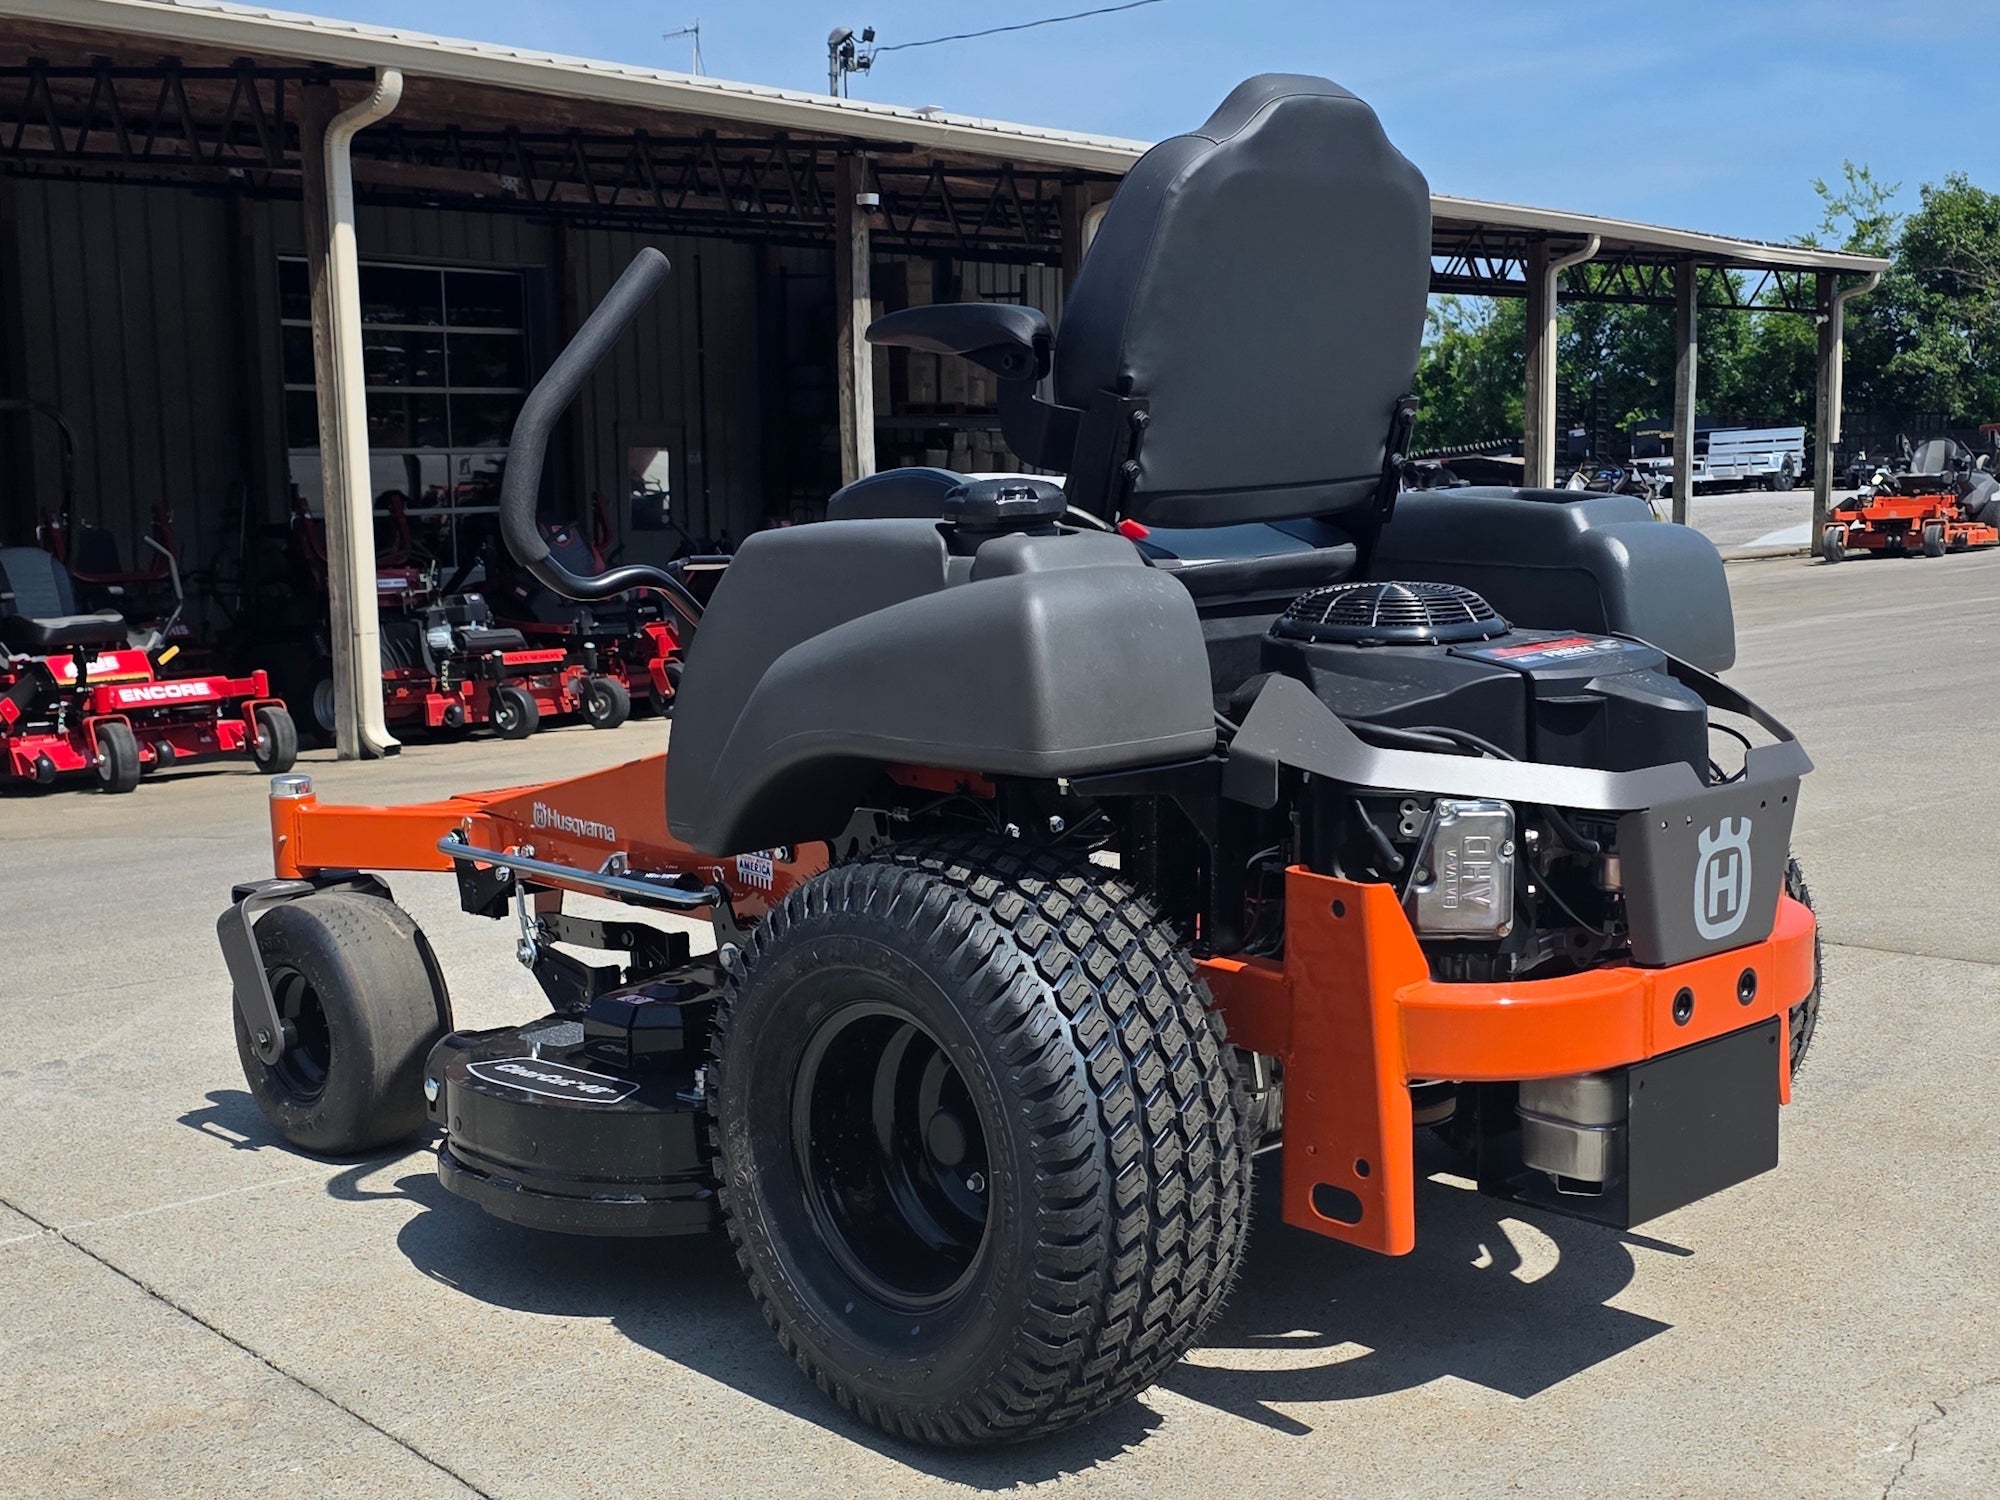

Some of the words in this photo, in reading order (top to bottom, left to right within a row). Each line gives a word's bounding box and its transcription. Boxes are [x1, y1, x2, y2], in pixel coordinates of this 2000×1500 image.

[118, 682, 211, 703] ENCORE
[546, 807, 616, 842] Husqvarna
[739, 859, 771, 876] AMERICA
[1461, 835, 1492, 909] OHV
